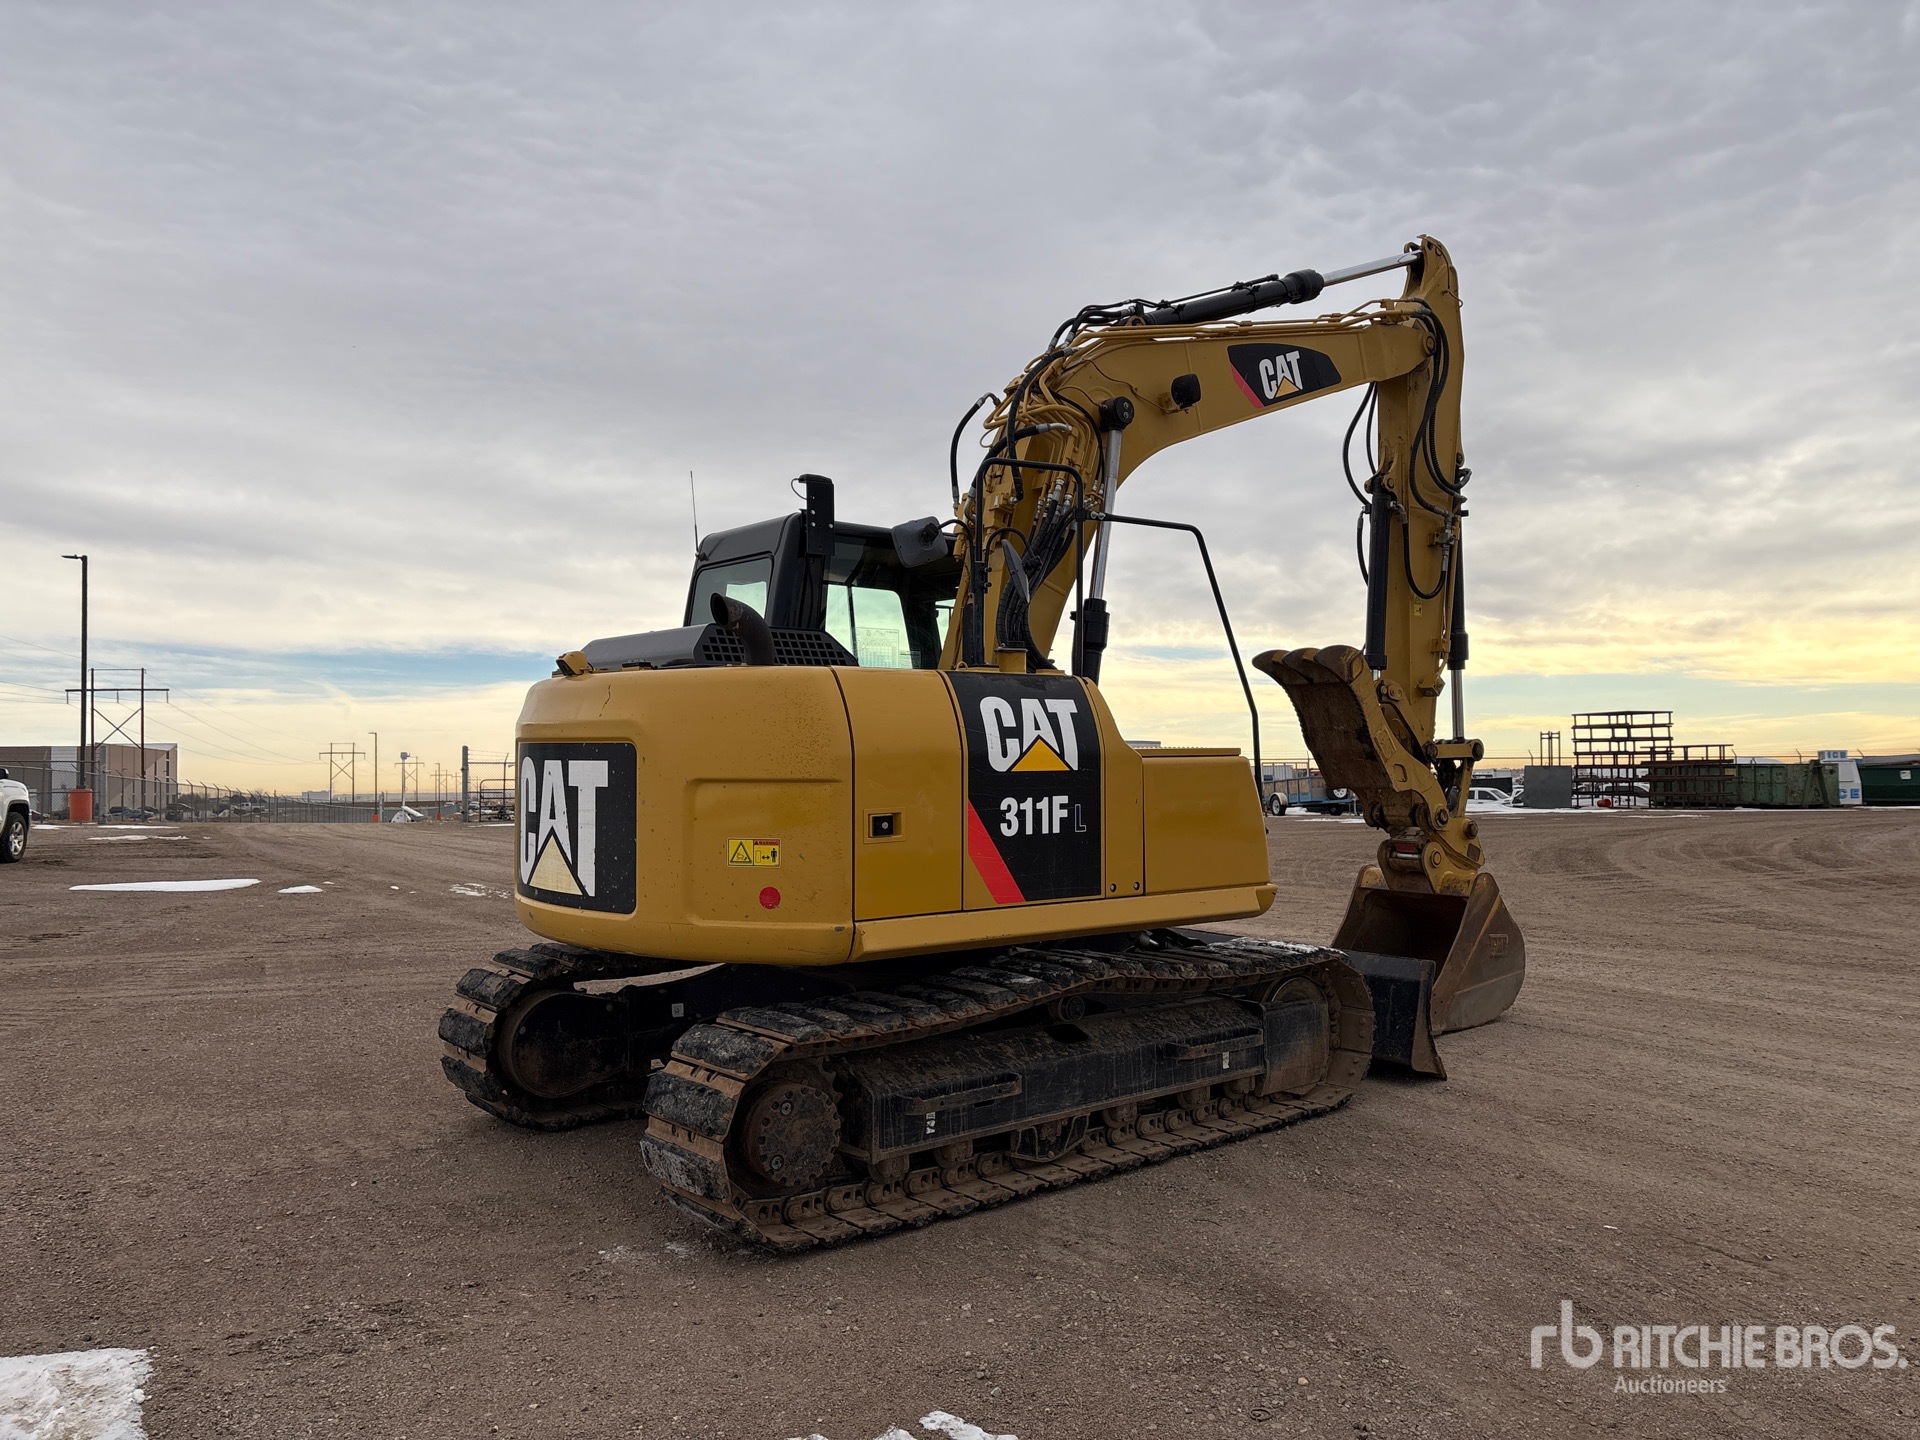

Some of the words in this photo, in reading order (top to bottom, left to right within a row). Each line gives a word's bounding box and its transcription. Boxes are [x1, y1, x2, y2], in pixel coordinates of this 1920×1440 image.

[1259, 351, 1303, 399] CAT
[980, 697, 1078, 772] CAT
[1827, 751, 1847, 759] ICE
[1838, 788, 1860, 799] CE
[520, 756, 609, 897] CAT
[1000, 796, 1069, 837] 311F
[1074, 803, 1087, 833] L
